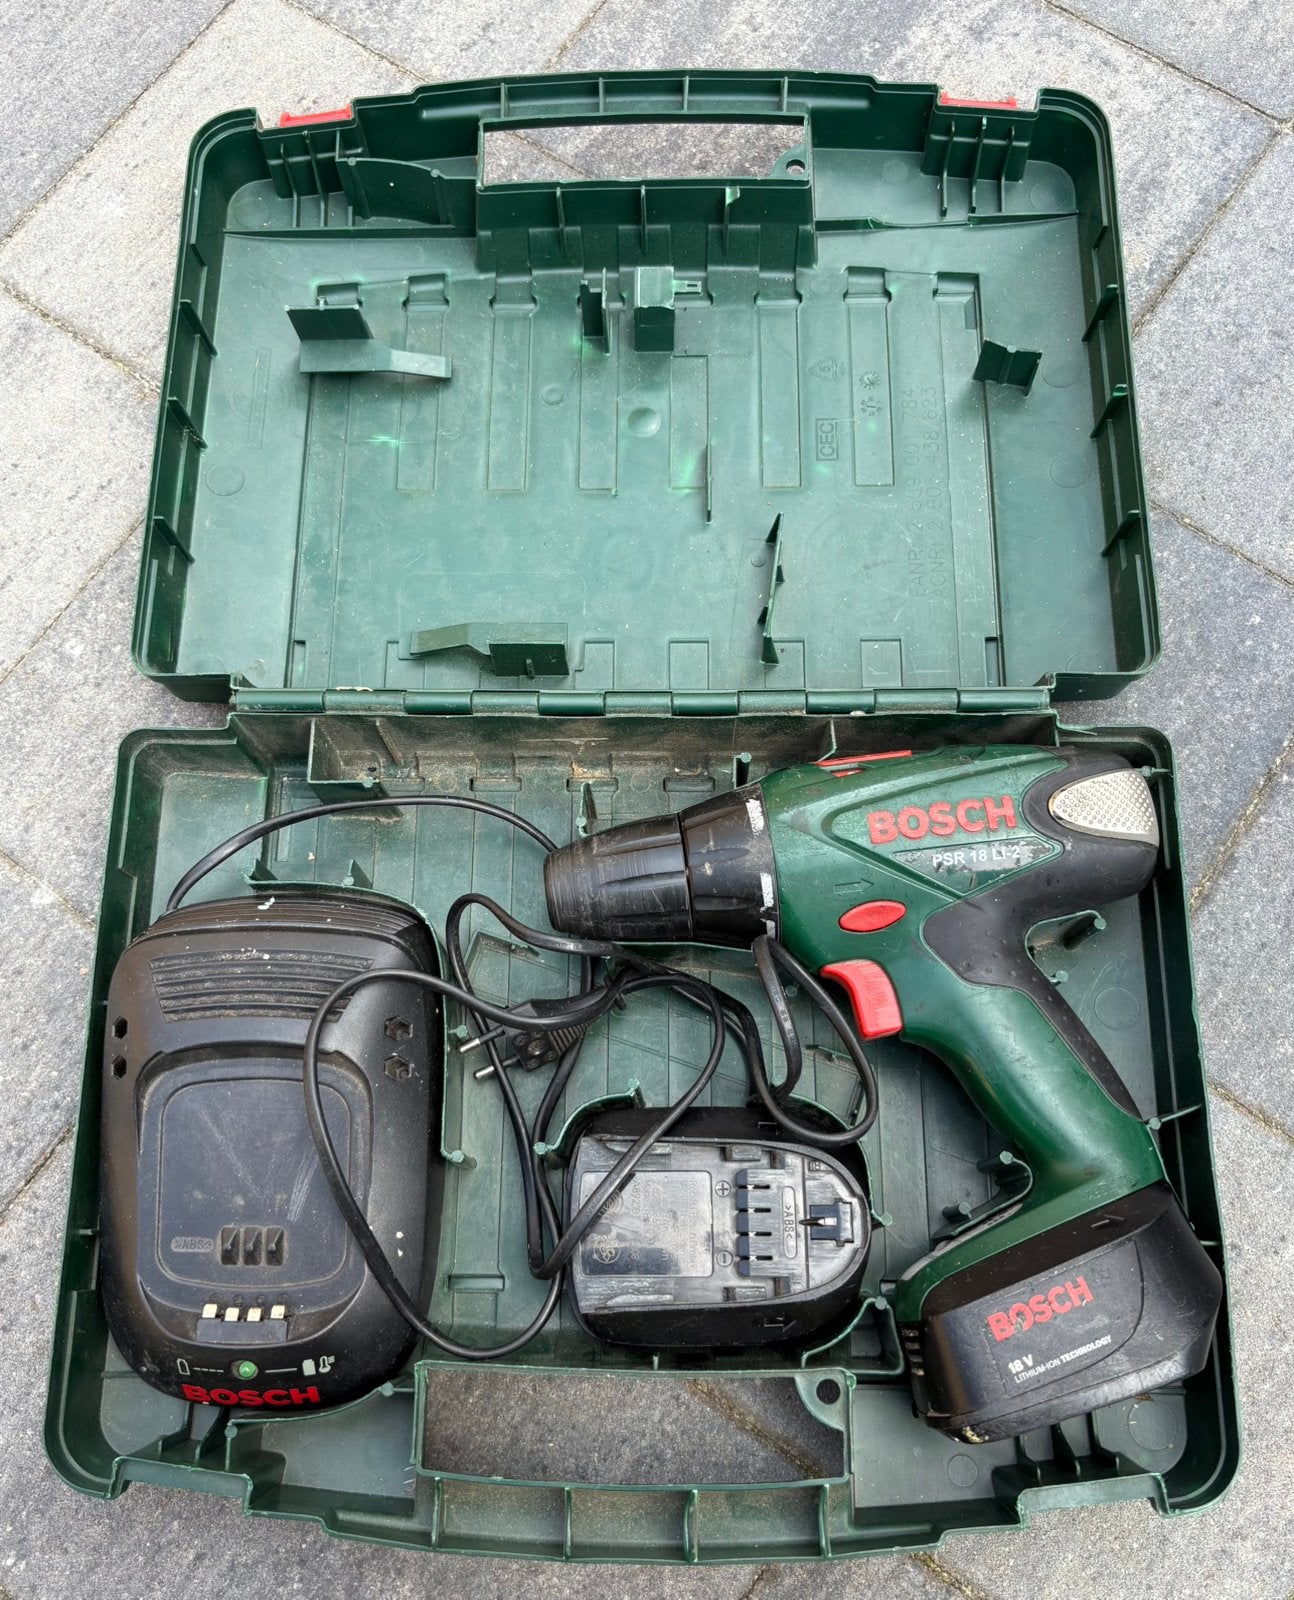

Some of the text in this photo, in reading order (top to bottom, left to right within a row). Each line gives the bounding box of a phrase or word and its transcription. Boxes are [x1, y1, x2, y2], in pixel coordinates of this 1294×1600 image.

[900, 387, 917, 423] 784
[920, 385, 938, 420] 623
[818, 422, 835, 458] CEC
[922, 430, 940, 464] 438
[906, 522, 924, 533] 2
[927, 520, 944, 531] 2
[866, 794, 1017, 845] BOSCH
[932, 851, 966, 868] PSR
[970, 848, 988, 863] 18
[784, 1204, 794, 1239] >ABS<
[987, 1276, 1095, 1342] BOSCH
[1007, 1353, 1034, 1375] 18 V
[1014, 1334, 1113, 1384] LITHIUM-ION TECHNOLOGY
[182, 1383, 321, 1406] BOSCH
